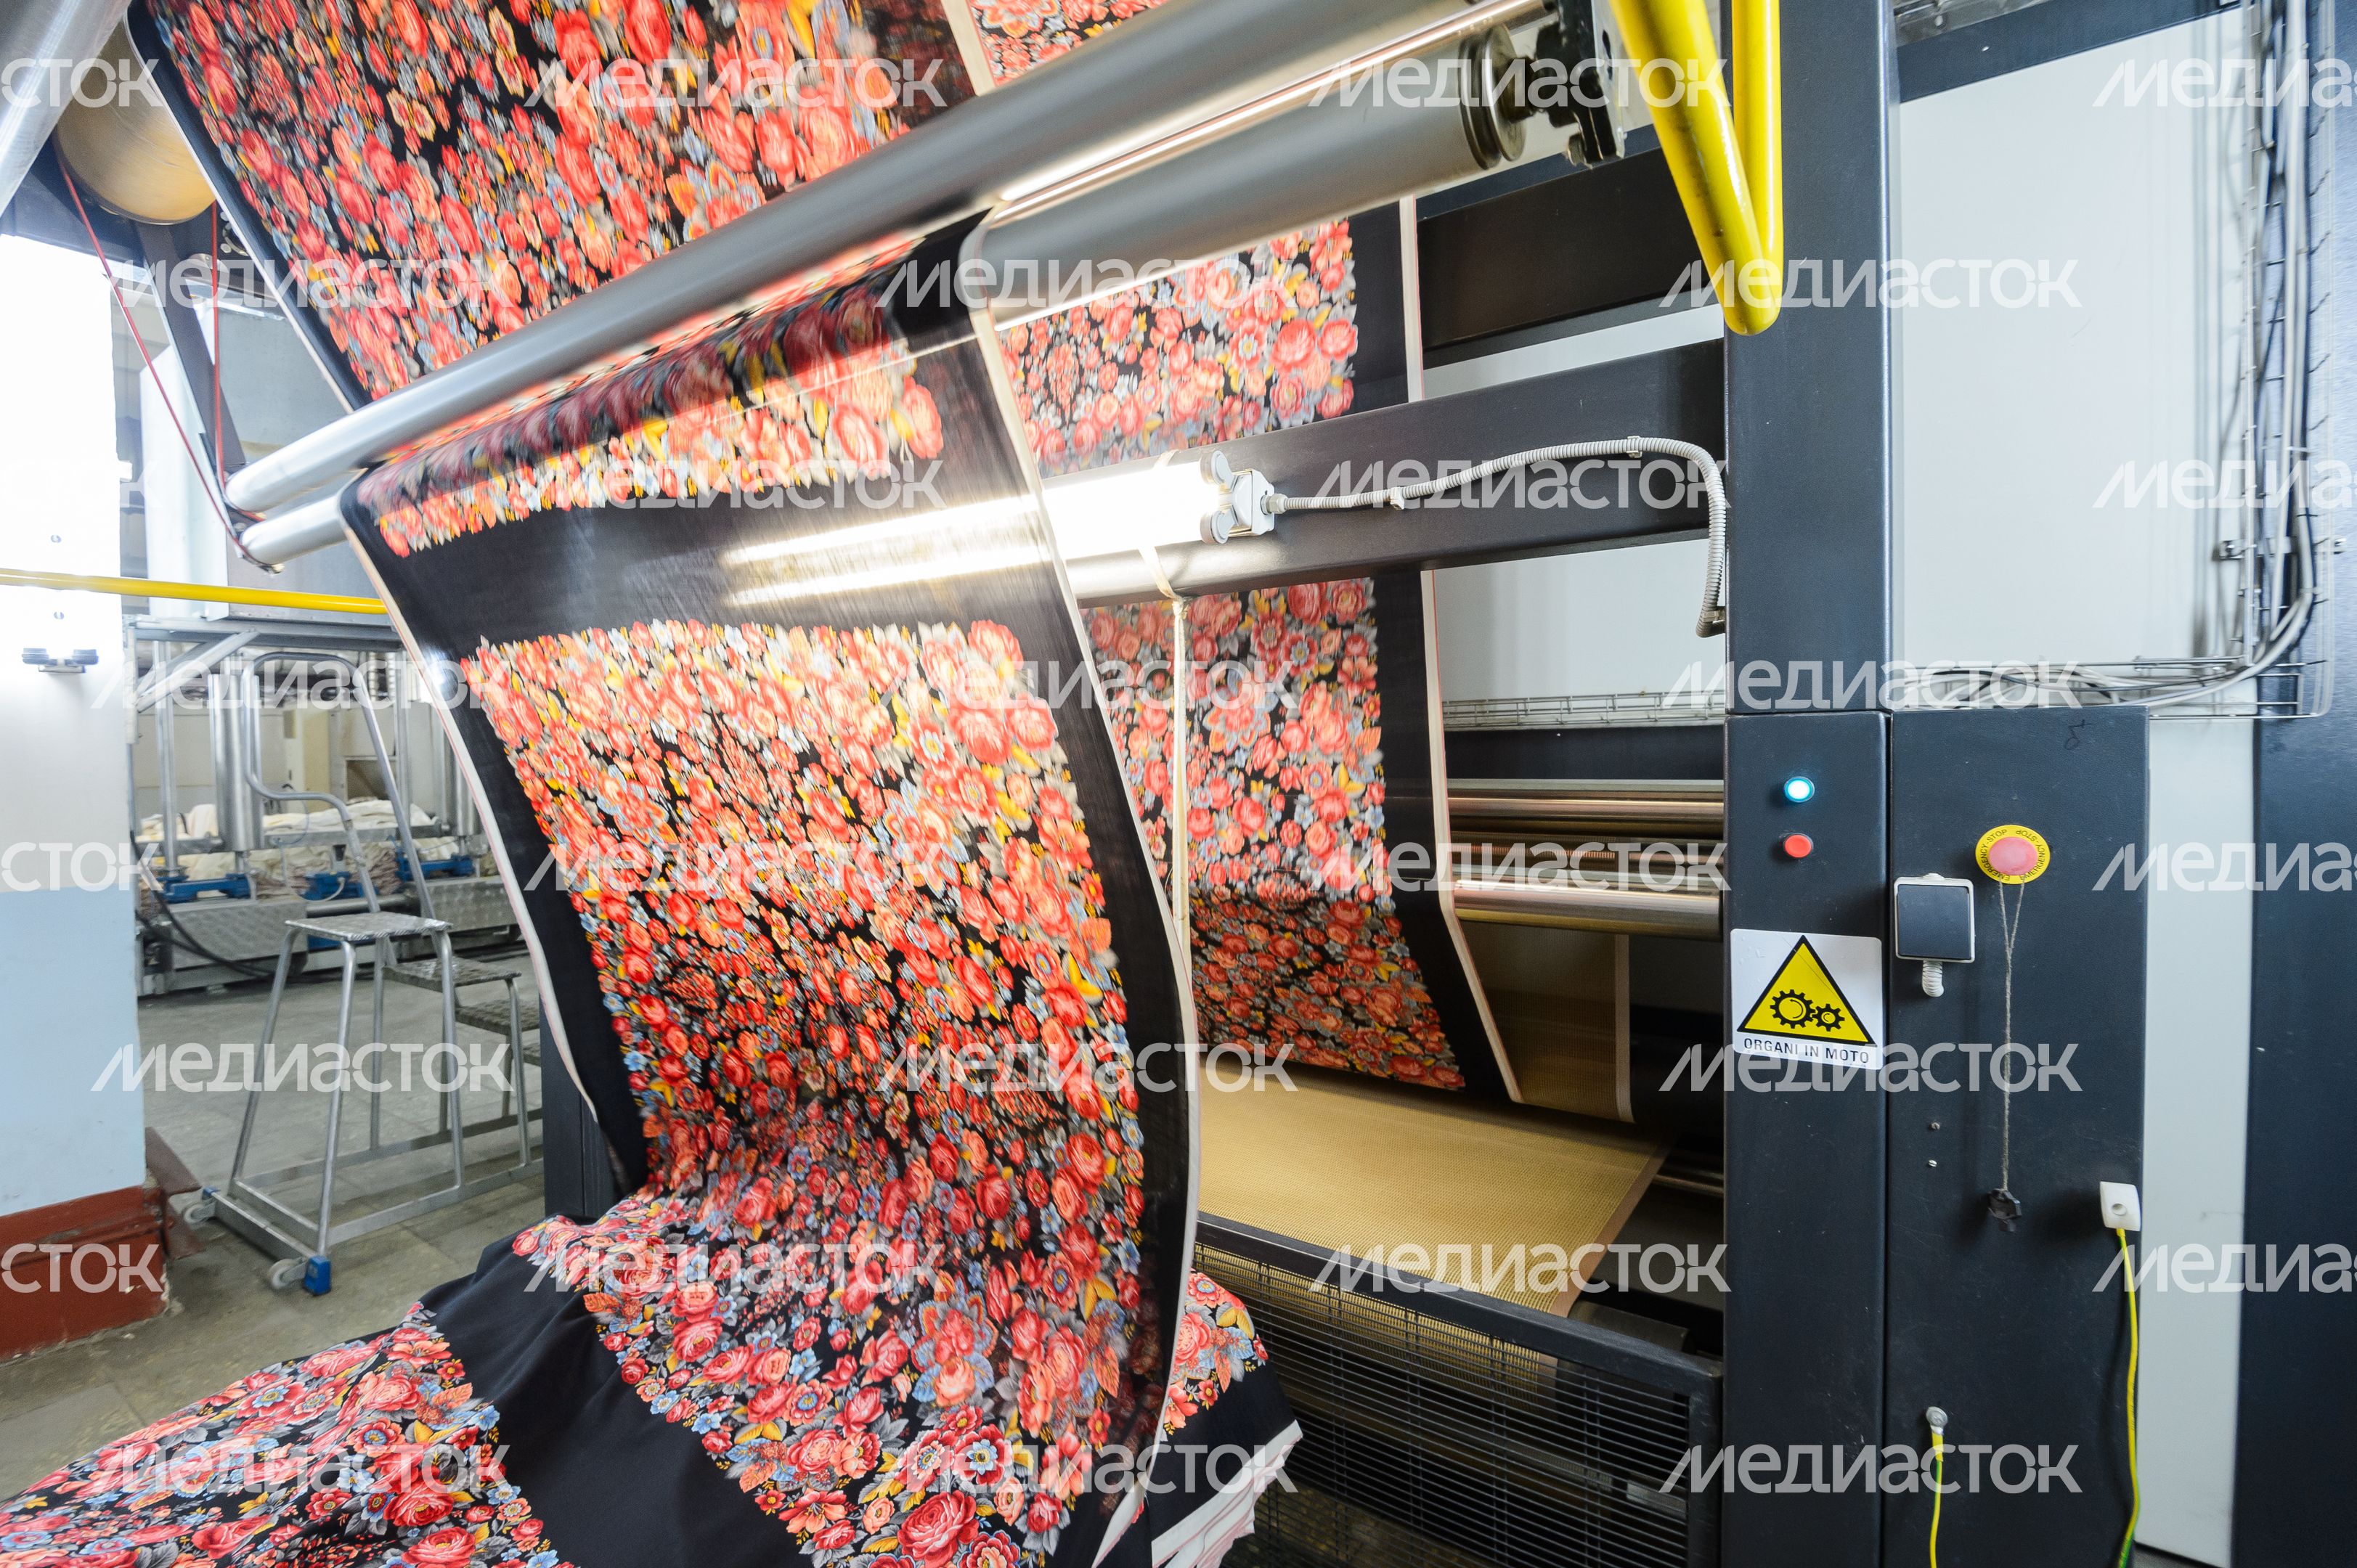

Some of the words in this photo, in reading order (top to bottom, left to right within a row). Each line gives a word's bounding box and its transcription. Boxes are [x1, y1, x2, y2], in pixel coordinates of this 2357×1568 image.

[1744, 1037, 1798, 1055] ORGANI
[1804, 1045, 1819, 1058] IN
[1825, 1048, 1869, 1063] MOTO
